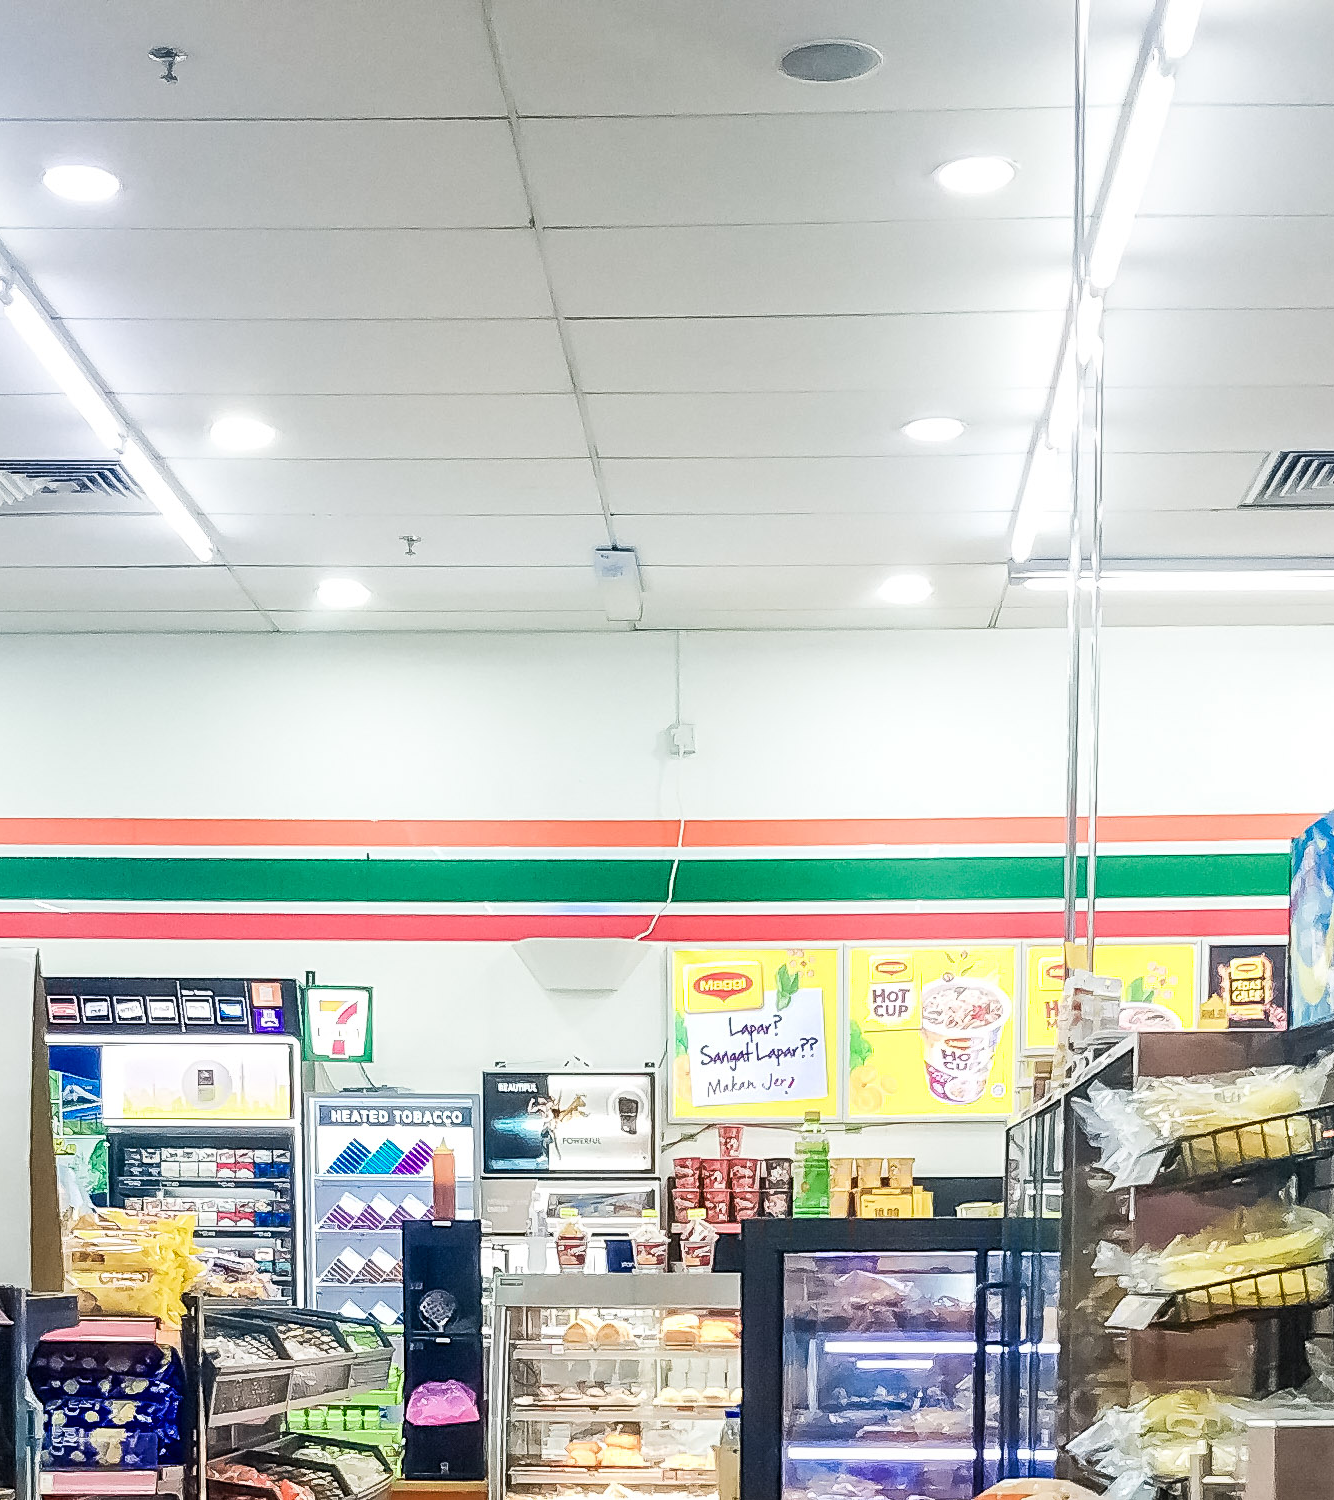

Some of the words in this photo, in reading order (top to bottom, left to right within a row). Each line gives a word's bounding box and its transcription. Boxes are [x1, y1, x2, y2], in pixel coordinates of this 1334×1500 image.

[872, 988, 910, 1004] HOT
[873, 1004, 909, 1018] CUP
[729, 1014, 782, 1043] Lapar?
[700, 1042, 753, 1071] Sangat
[755, 1037, 819, 1067] Lapar??
[707, 1076, 756, 1098] Makan
[331, 1110, 389, 1124] HEATED
[392, 1110, 463, 1124] TOBACCO
[562, 1137, 602, 1145] POWERFUL
